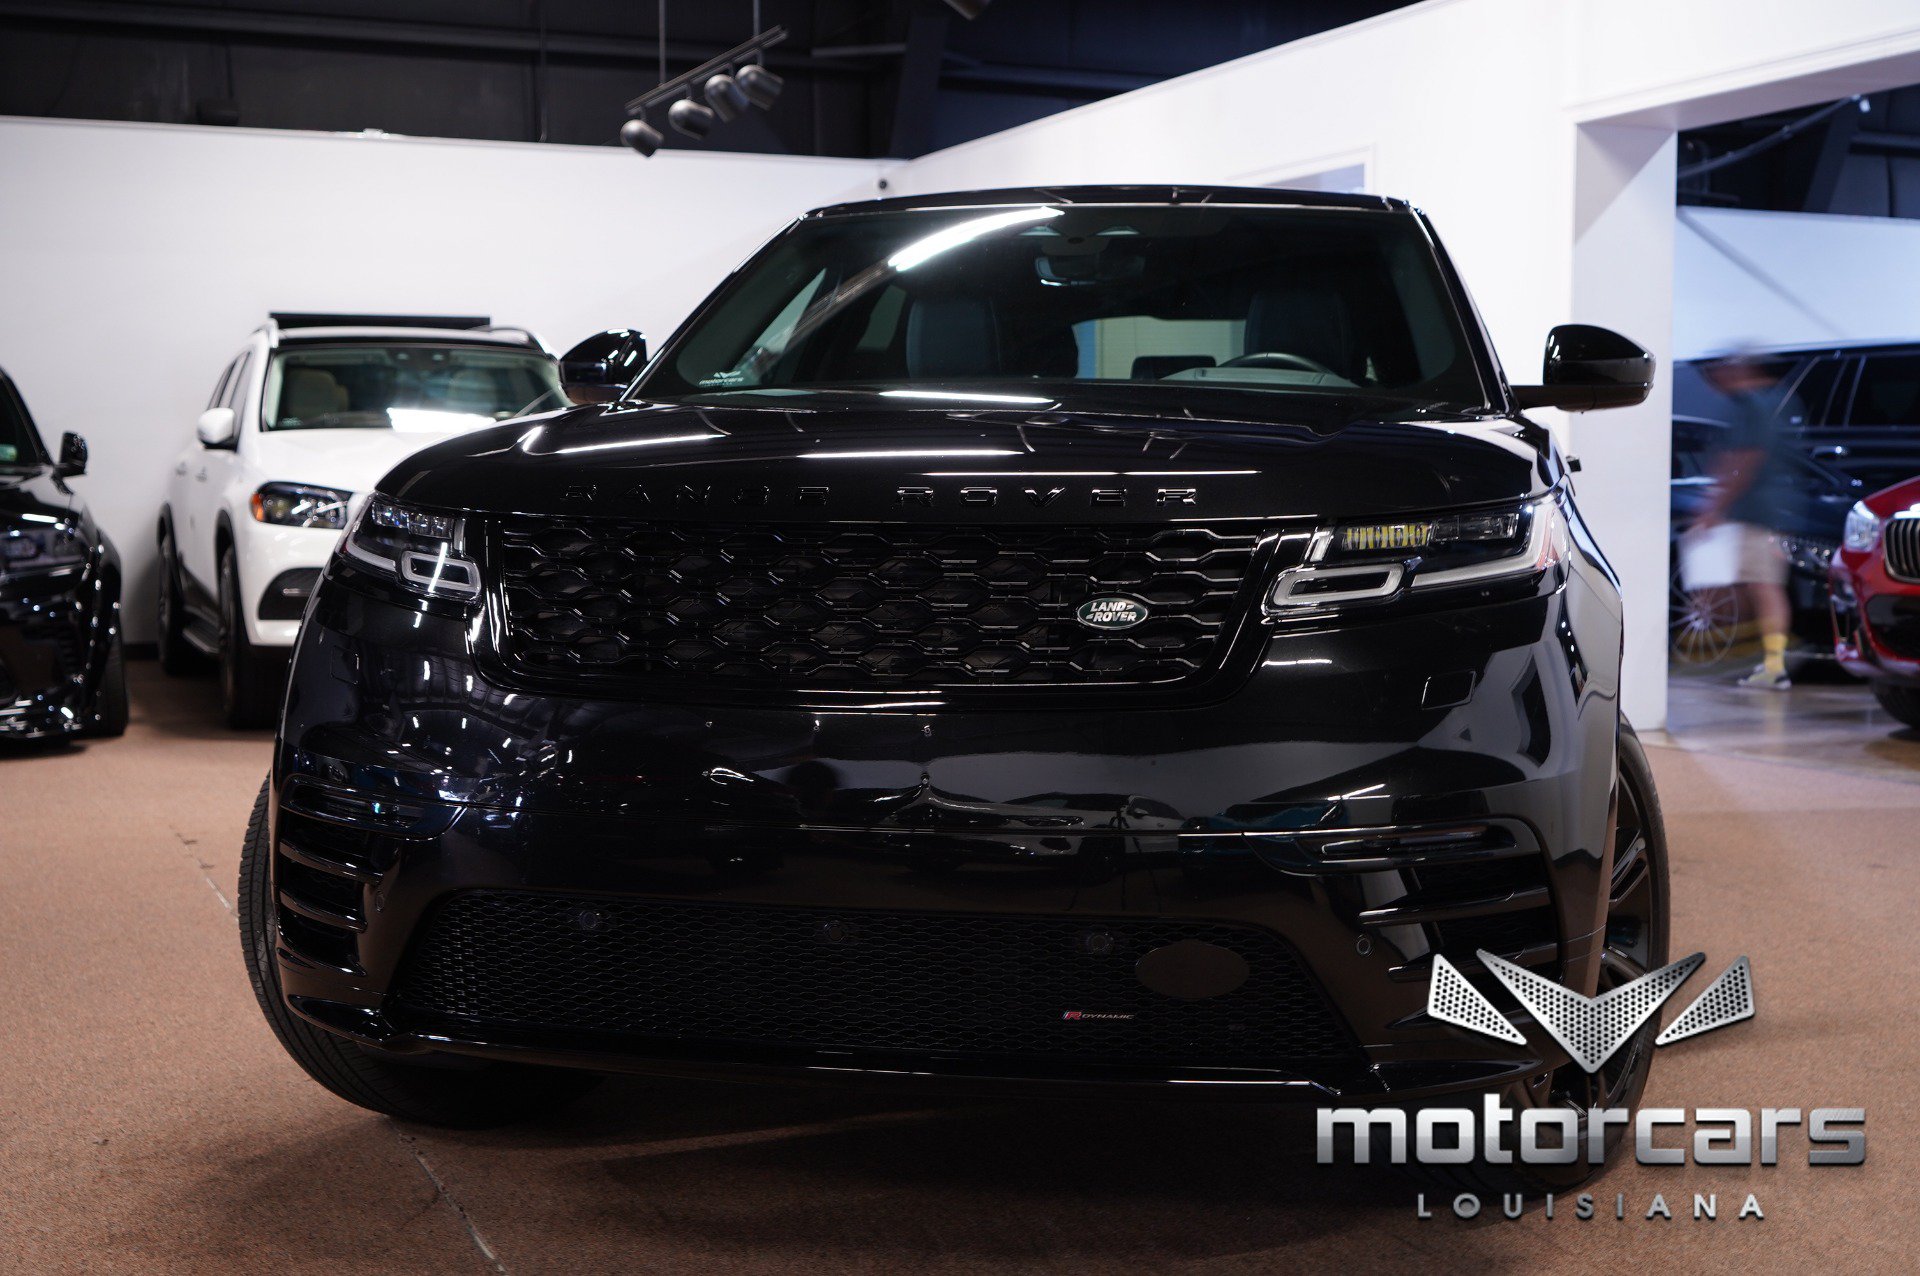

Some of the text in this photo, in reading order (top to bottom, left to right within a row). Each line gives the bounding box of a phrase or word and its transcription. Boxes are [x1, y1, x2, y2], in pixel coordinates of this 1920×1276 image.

[897, 486, 1196, 507] ROVER
[1090, 602, 1126, 612] LAND
[1092, 612, 1137, 622] ROVER
